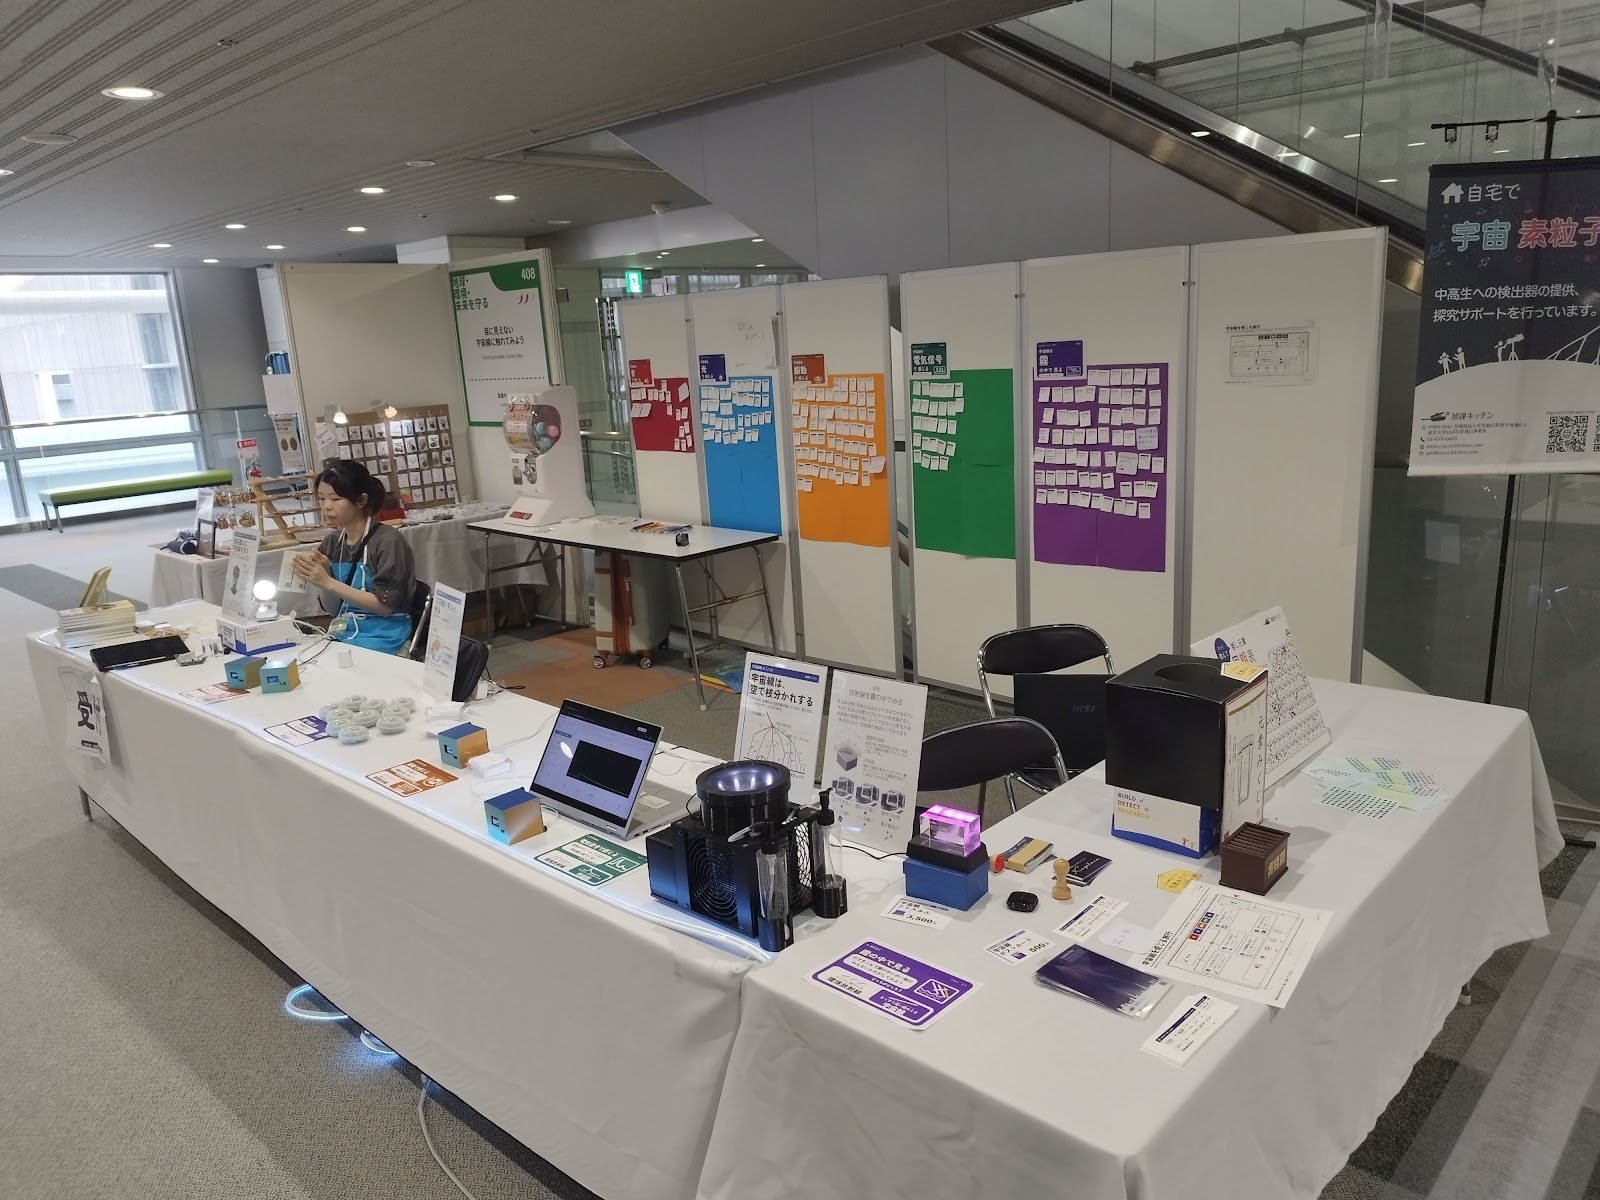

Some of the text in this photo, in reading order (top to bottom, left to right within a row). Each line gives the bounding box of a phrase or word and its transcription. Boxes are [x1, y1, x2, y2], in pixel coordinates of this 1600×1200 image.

[1468, 183, 1521, 202] 自宅で
[1451, 216, 1600, 252] 宇宙 素粒子
[521, 267, 536, 280] 408
[1433, 304, 1597, 322] 探究サポートを行っています。
[749, 684, 813, 707] 空で枝分かれする
[1117, 792, 1136, 802] BUILD
[1117, 799, 1141, 810] DETECT
[857, 948, 912, 973] 霧の中で見る
